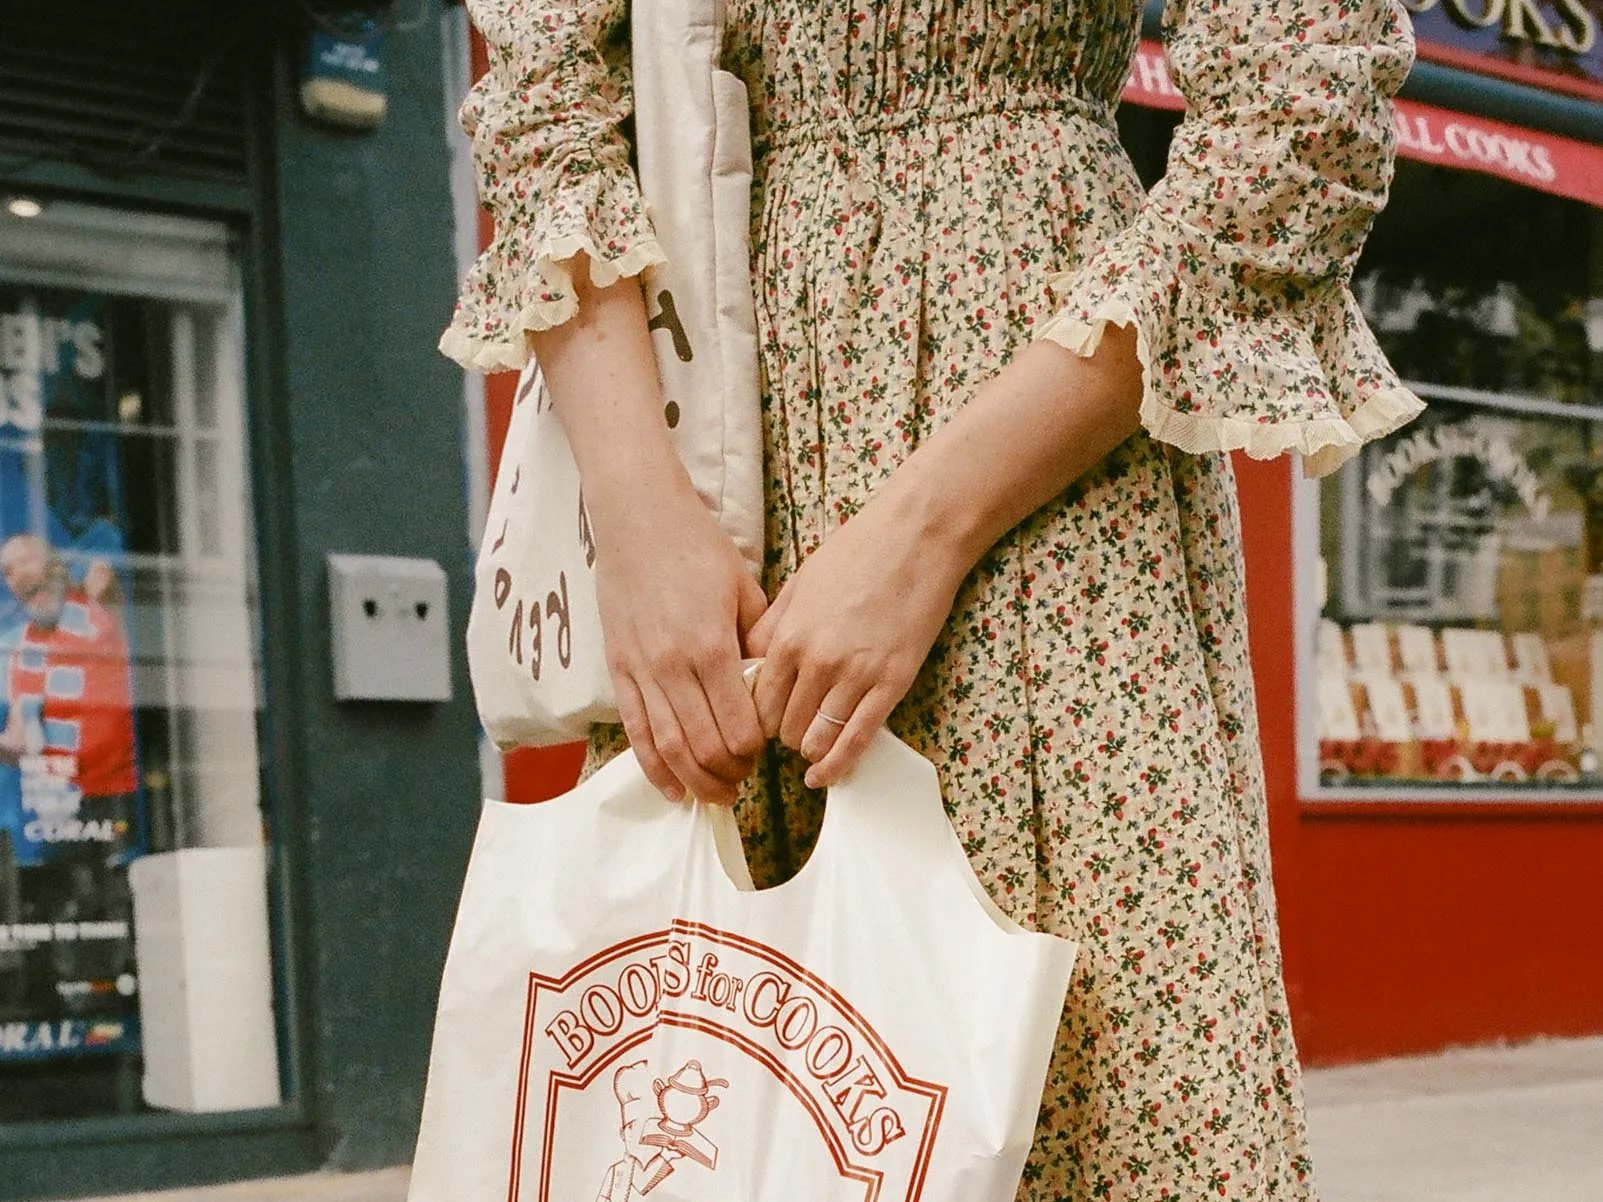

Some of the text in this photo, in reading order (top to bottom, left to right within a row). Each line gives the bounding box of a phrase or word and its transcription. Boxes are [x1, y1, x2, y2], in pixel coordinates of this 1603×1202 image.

[1395, 111, 1556, 183] LL COOKS
[0, 1020, 81, 1052] RAL
[545, 940, 906, 1156] BOOS for COOKS
